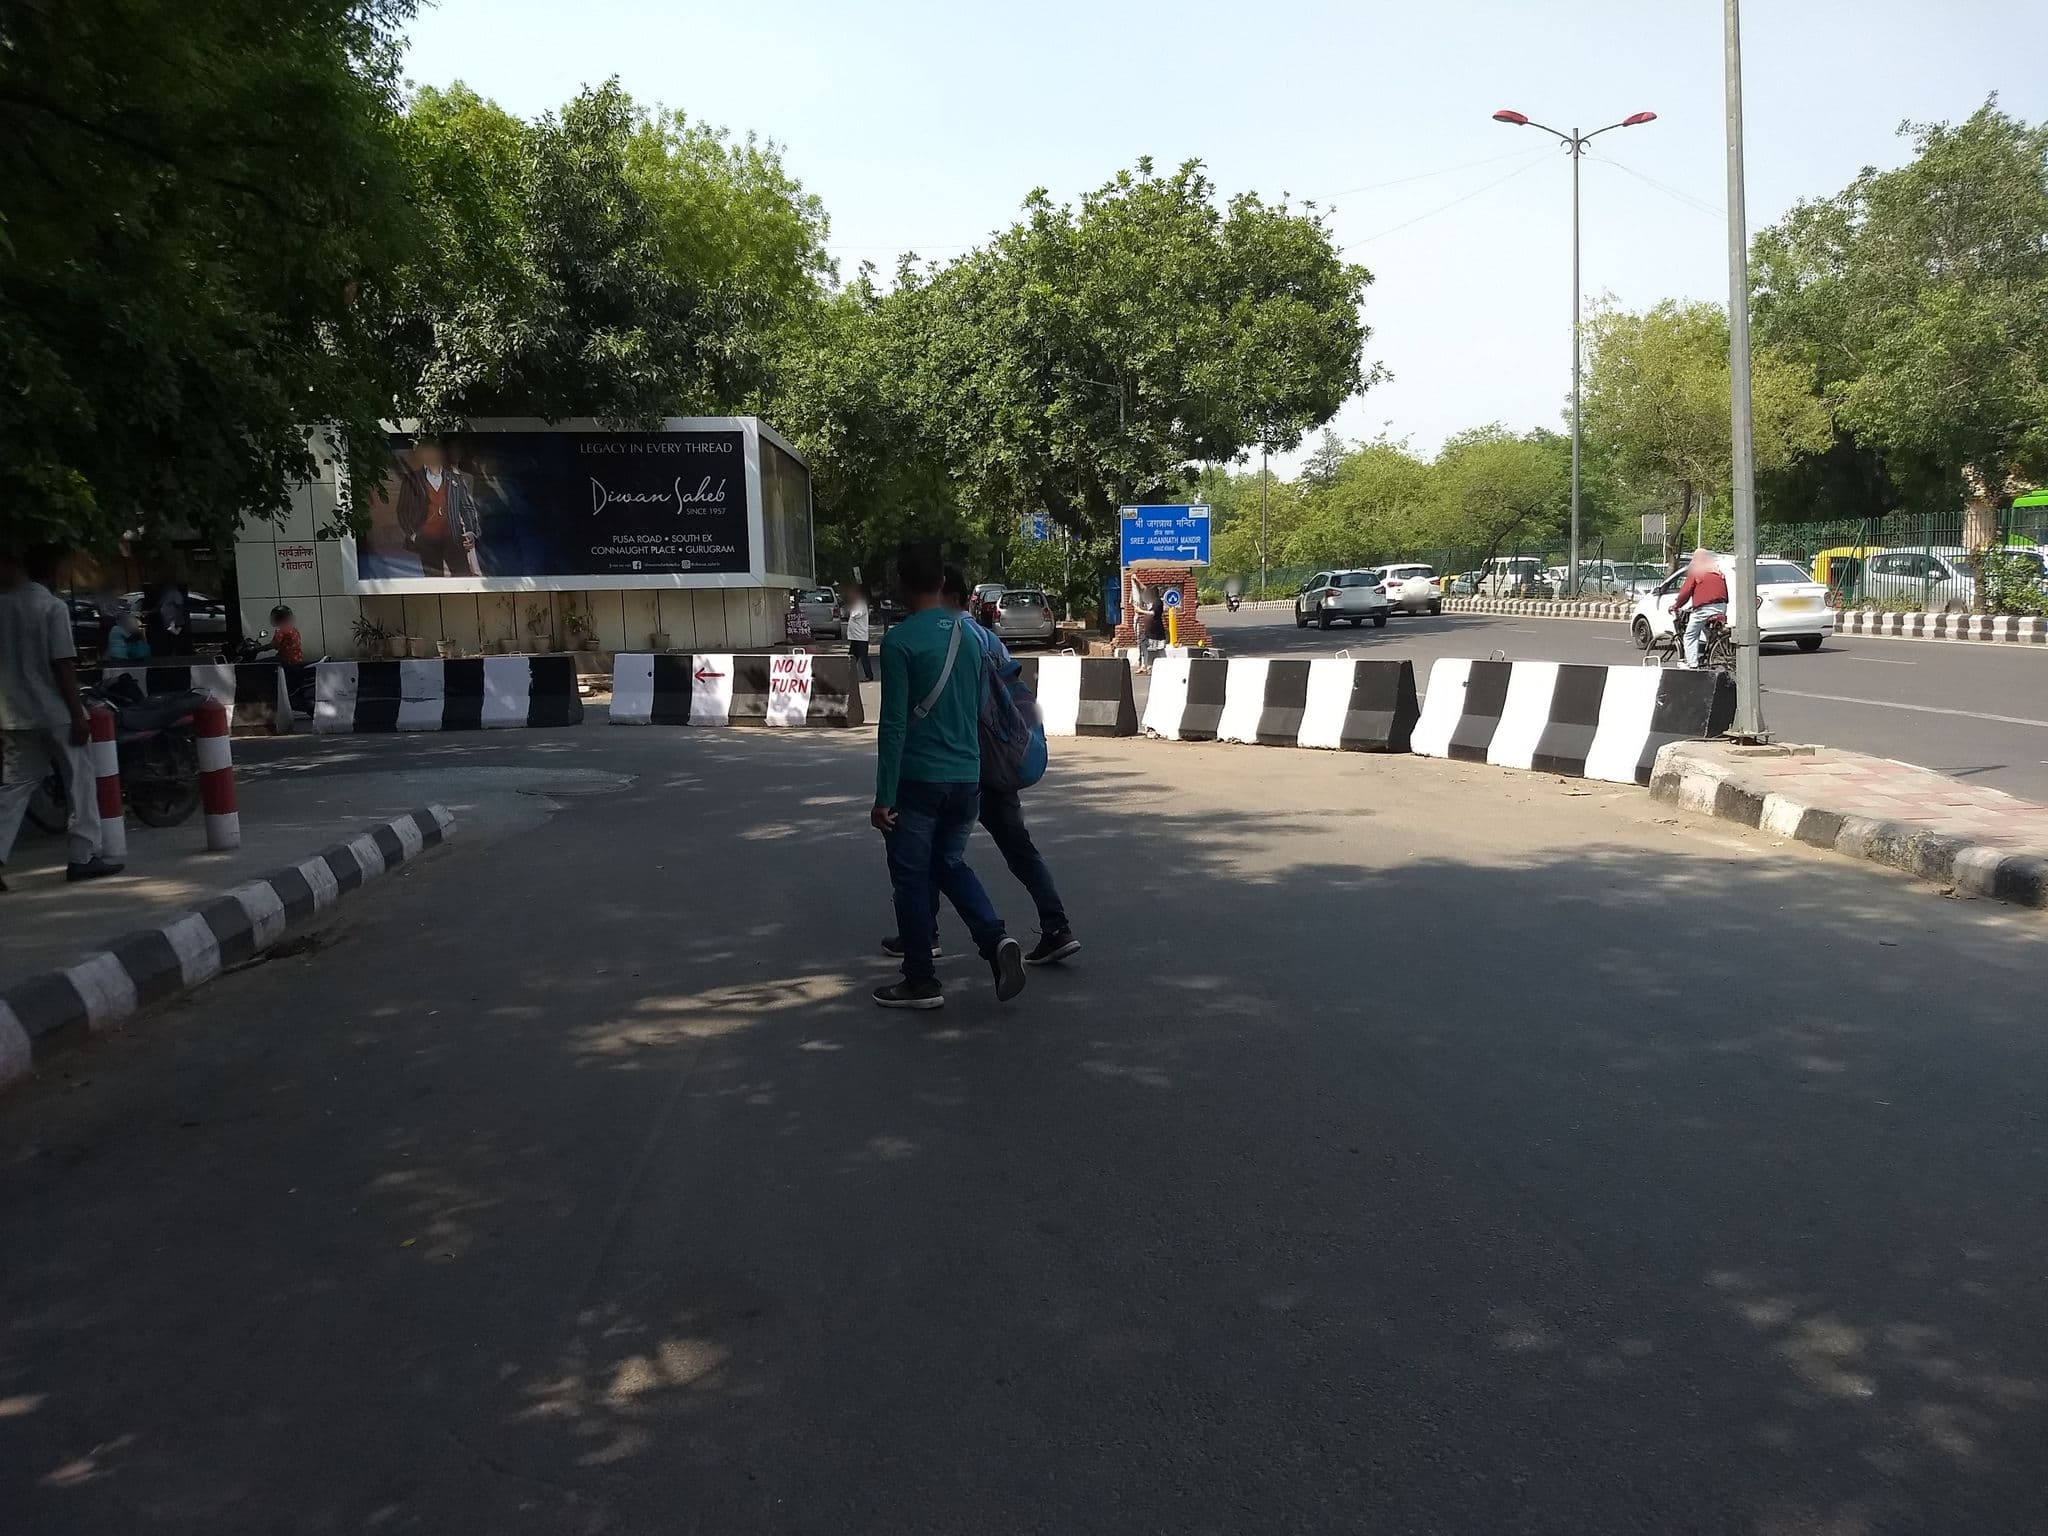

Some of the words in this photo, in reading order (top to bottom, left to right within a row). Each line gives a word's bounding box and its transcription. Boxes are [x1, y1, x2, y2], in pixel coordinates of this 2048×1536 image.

[580, 443, 628, 453] LEGACY
[631, 443, 643, 453] IN
[646, 443, 682, 453] EVERY
[685, 443, 733, 453] THREAD
[590, 476, 672, 516] Diwan
[674, 476, 727, 515] Saheb
[1135, 518, 1144, 528] श्री
[612, 535, 635, 543] PUSA
[637, 535, 662, 543] ROAD
[671, 534, 700, 543] SOUTH
[702, 534, 713, 542] EX
[1130, 537, 1145, 545] SREE
[1146, 536, 1179, 545] JAGANNATH
[1180, 536, 1202, 544] MANDIR
[591, 546, 649, 555] CONNAUGHT
[650, 546, 676, 554] PLACE
[685, 545, 736, 554] GURUGRAM
[773, 659, 794, 674] NO
[796, 659, 808, 673] U
[771, 678, 809, 694] TURN
